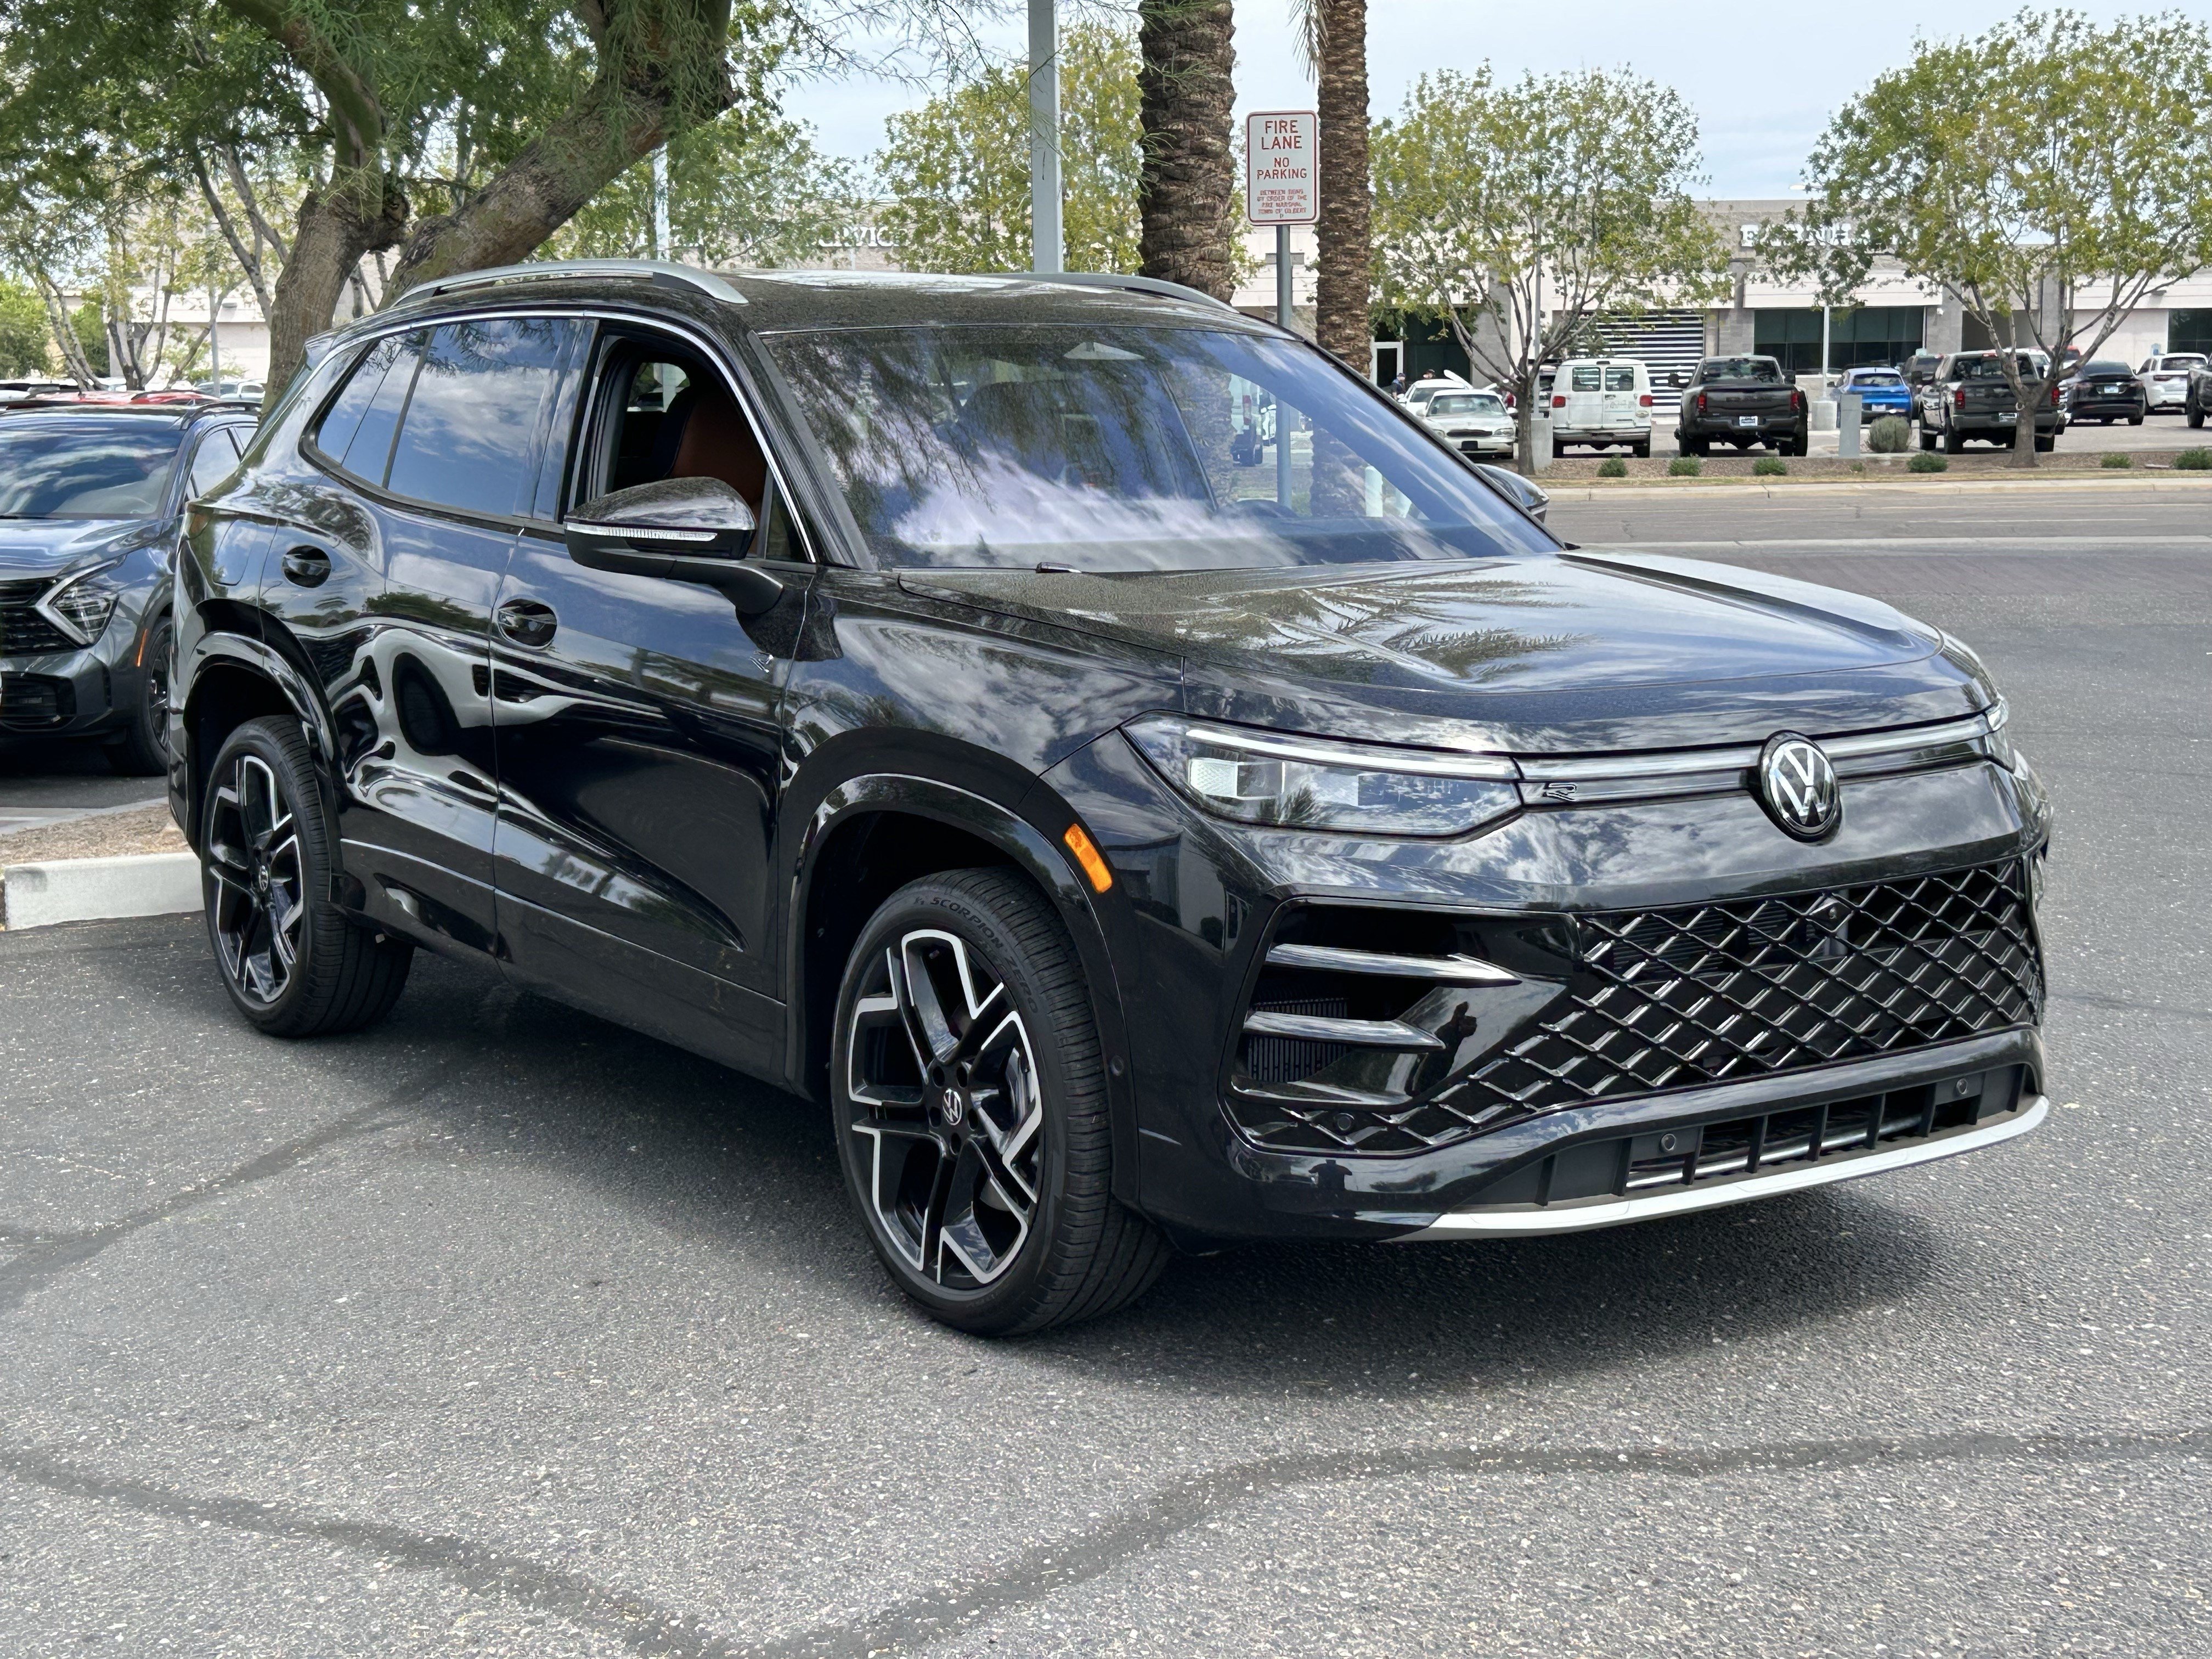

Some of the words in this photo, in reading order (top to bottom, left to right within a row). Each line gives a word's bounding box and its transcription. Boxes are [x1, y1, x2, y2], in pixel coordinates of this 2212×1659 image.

[1265, 120, 1299, 134] FIRE
[1261, 136, 1302, 150] LANE
[1274, 157, 1290, 167] NO
[1256, 168, 1307, 180] PARKING
[930, 896, 1003, 949] SCORPION
[1004, 955, 1039, 1013] ZERO
